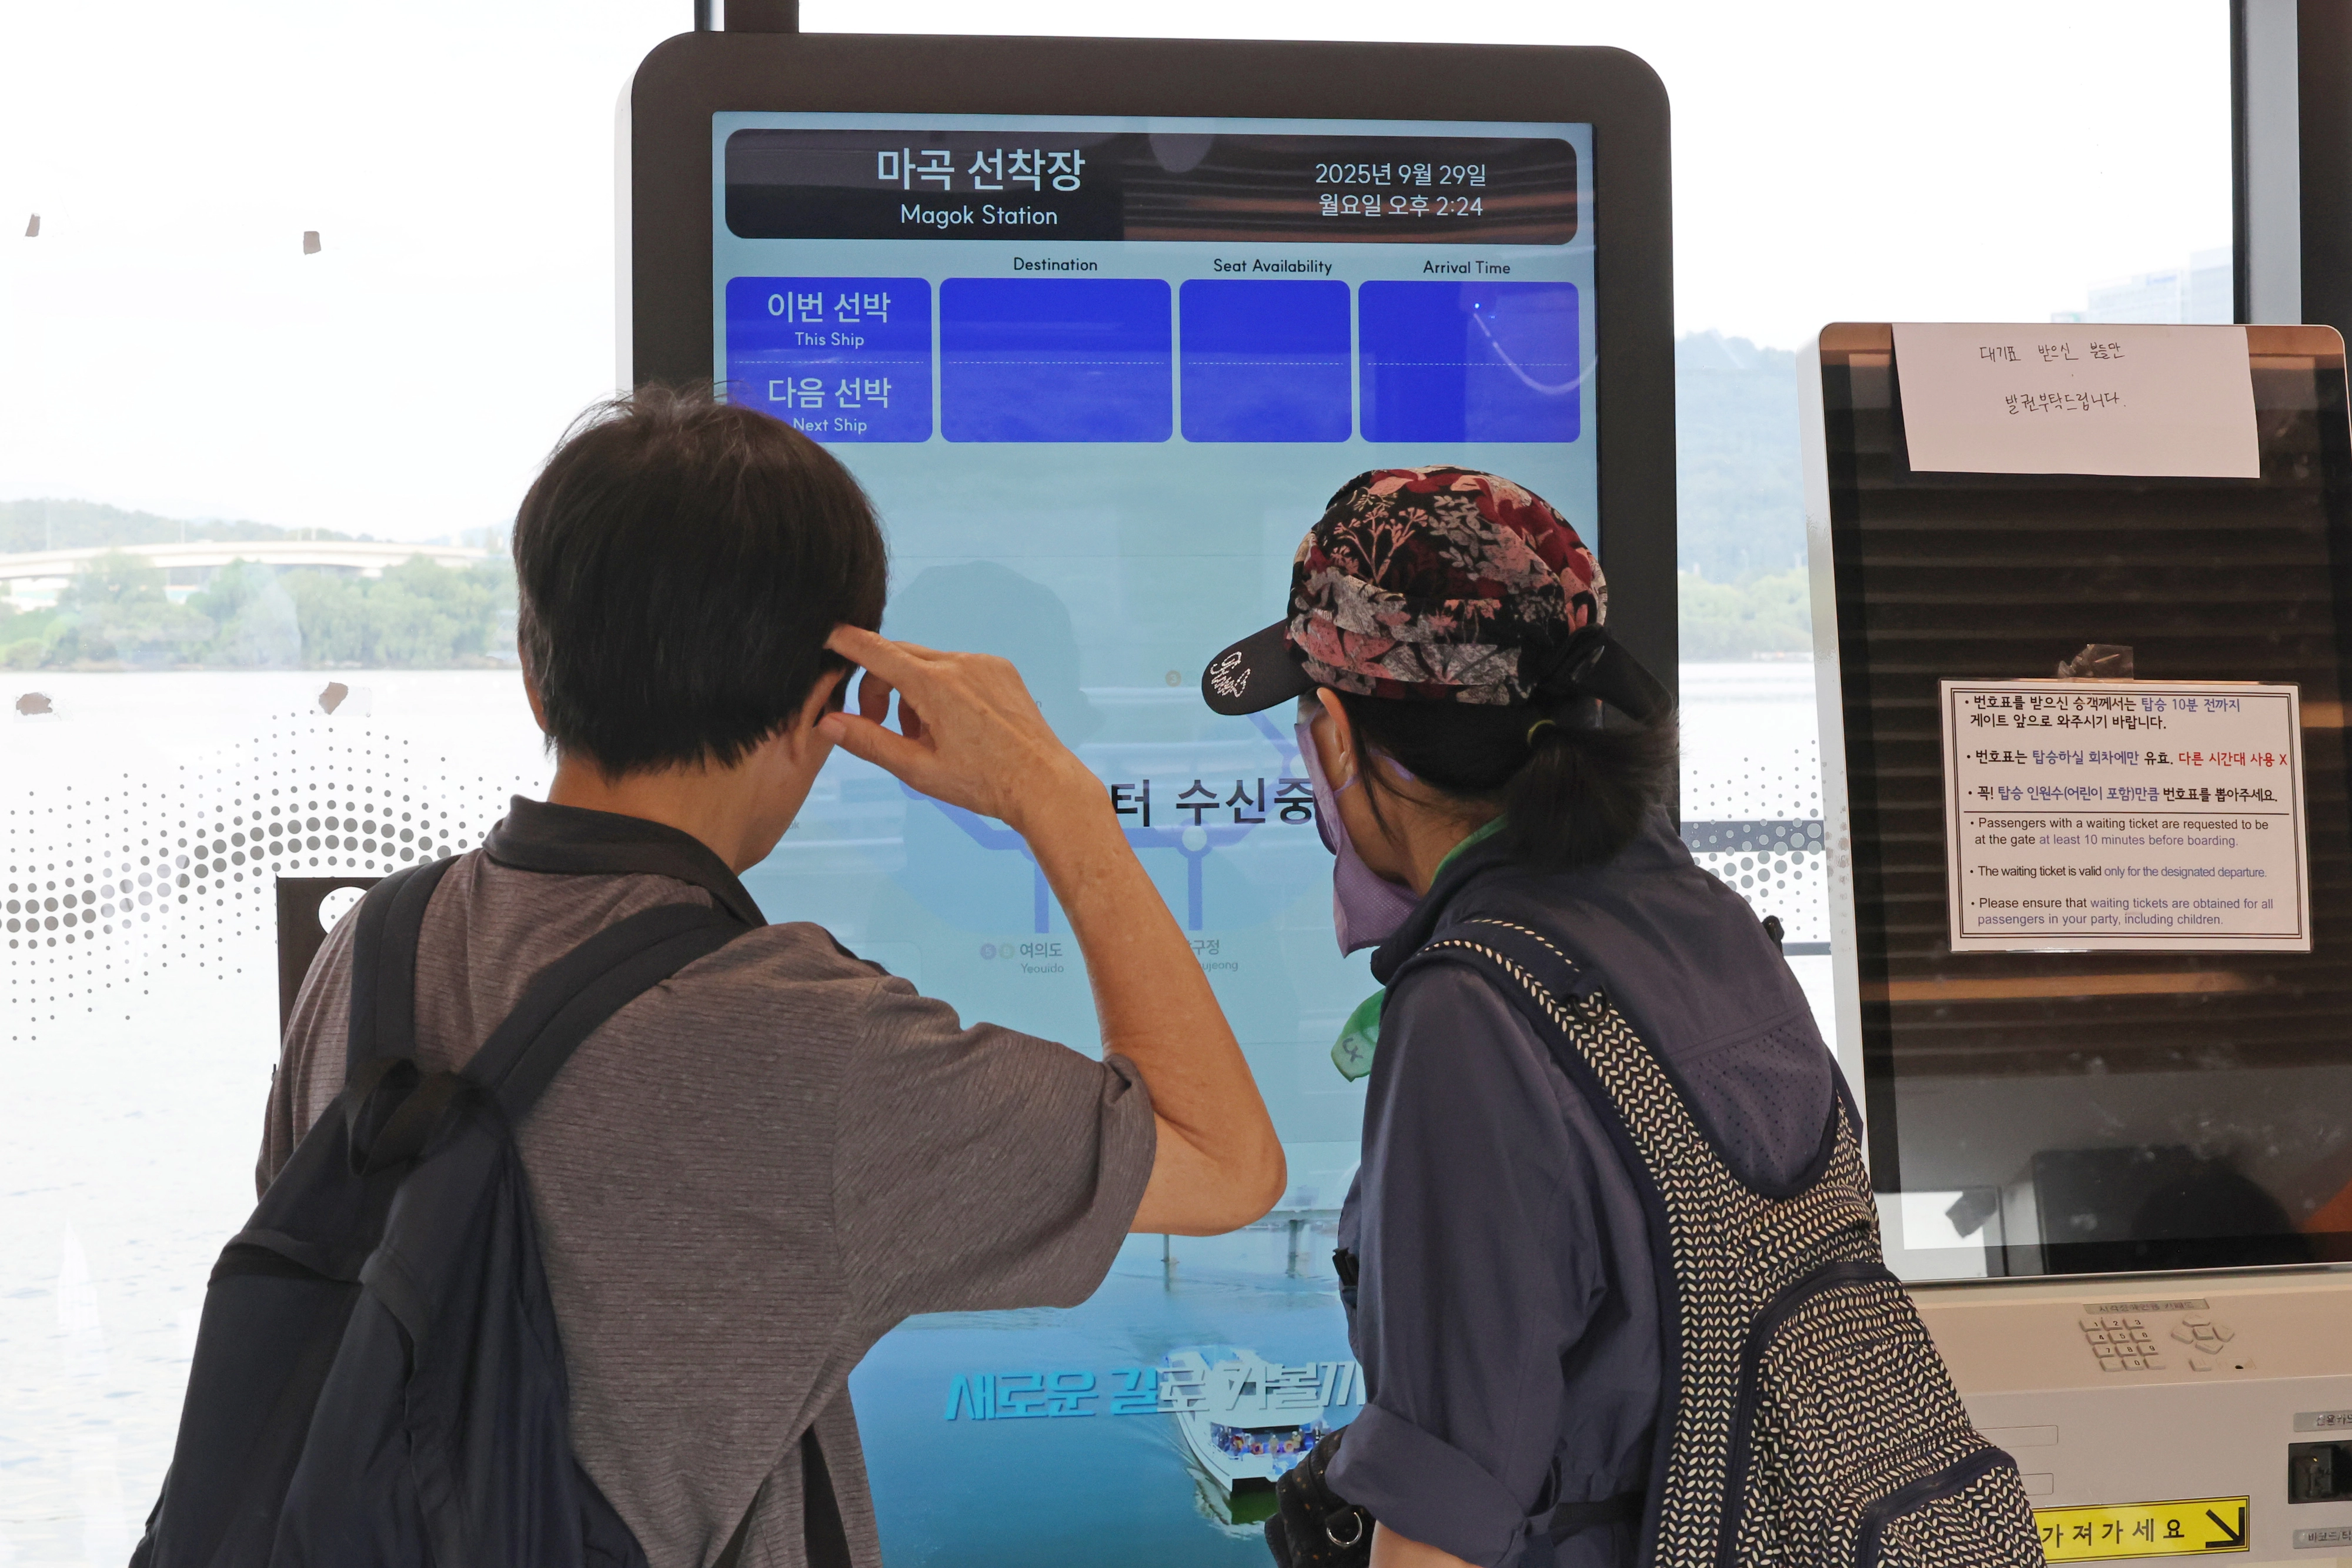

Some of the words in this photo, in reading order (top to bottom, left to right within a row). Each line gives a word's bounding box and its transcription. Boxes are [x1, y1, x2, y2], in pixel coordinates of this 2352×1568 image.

[878, 148, 955, 190] 마곡
[968, 148, 1086, 192] 선착장
[1315, 163, 1391, 186] 2025년
[1398, 163, 1432, 186] 9월
[1439, 164, 1486, 186] 29일
[1319, 193, 1381, 217] 월요일
[1388, 194, 1430, 218] 오후
[1436, 196, 1484, 216] 2:24
[901, 203, 974, 229] Magok
[982, 205, 1058, 225] Station
[1014, 257, 1098, 271] Destination
[1213, 258, 1247, 273] Seat
[1252, 259, 1333, 276] Availability
[1423, 260, 1471, 275] Arrival
[1475, 260, 1511, 275] Time
[768, 291, 823, 323] 이번
[834, 292, 891, 323] 선박
[795, 332, 826, 346] This
[831, 332, 865, 349] Ship
[1979, 346, 2021, 362] 대기표
[2038, 342, 2079, 362] 받으신
[2090, 342, 2126, 359] 분들만
[769, 377, 826, 408] 다음
[834, 377, 892, 409] 선박
[794, 417, 828, 432] Next
[834, 417, 868, 435] Ship
[1974, 695, 2026, 710] 번호표를
[2030, 696, 2068, 711] 받으신
[2073, 696, 2137, 711] 승객께서는
[2141, 697, 2167, 712] 탑승
[2172, 698, 2199, 713] 10분
[2203, 698, 2240, 713] 전까지
[1970, 713, 2009, 728] 게이트
[2013, 714, 2053, 728] 앞으로
[2057, 714, 2107, 729] 와주시기
[2112, 715, 2167, 730] 바랍니다.
[1976, 750, 2027, 764] 번호표는
[2033, 750, 2084, 765] 탑승하실
[2089, 750, 2140, 765] 회차에만
[2144, 751, 2173, 765] 유효.
[2179, 751, 2204, 766] 다른
[2209, 751, 2246, 766] 시간대
[2250, 752, 2275, 767] 사용
[2279, 753, 2288, 765] X
[1175, 777, 1315, 825] 수신중
[1977, 785, 1994, 801] 꼭!
[1998, 785, 2023, 801] 탑승
[2027, 785, 2103, 801] 인원수(어린이
[2106, 786, 2160, 802] 포함)만큼
[2163, 787, 2211, 802] 번호표를
[2214, 787, 2278, 803] 뽑아주세요.
[1978, 817, 2046, 830] Passengers
[2049, 818, 2072, 828] with
[2076, 820, 2083, 828] a
[2086, 818, 2126, 831] waiting
[2129, 818, 2159, 829] ticket
[2161, 820, 2180, 829] are
[2183, 819, 2238, 831] requested
[2241, 820, 2252, 830] to
[2255, 820, 2269, 830] be
[1975, 834, 1986, 845] at
[1989, 834, 2007, 845] the
[2010, 835, 2036, 847] gate
[2039, 834, 2050, 845] at
[2053, 834, 2081, 845] least
[2084, 834, 2098, 845] 10
[2101, 834, 2145, 845] minutes
[2149, 835, 2184, 845] before
[2187, 835, 2239, 848] boarding.
[1978, 865, 1999, 877] The
[2001, 865, 2037, 878] waiting
[2040, 865, 2066, 877] ticket
[2068, 865, 2077, 877] is
[2079, 865, 2102, 877] valid
[2104, 865, 2125, 879] only
[2127, 866, 2141, 877] for
[2143, 866, 2159, 877] the
[2161, 866, 2216, 880] designated
[2218, 867, 2267, 880] departure.
[1979, 898, 2019, 908] Please
[2022, 899, 2062, 908] ensure
[2065, 897, 2087, 908] that
[2090, 897, 2130, 910] waiting
[2133, 898, 2169, 908] tickets
[2171, 900, 2190, 909] are
[2193, 898, 2240, 909] obtained
[2243, 898, 2259, 909] for
[2261, 899, 2274, 910] all
[1978, 914, 2045, 927] passengers
[2049, 914, 2059, 924] in
[2062, 915, 2087, 927] your
[2090, 914, 2121, 927] party,
[2124, 913, 2174, 927] including
[2177, 914, 2224, 925] children.
[1020, 942, 1063, 959] 여의도
[1187, 939, 1220, 956] 구정
[1021, 962, 1065, 974] Yeouido
[944, 1369, 1099, 1421] 새로운
[1109, 1362, 1210, 1415] 길로
